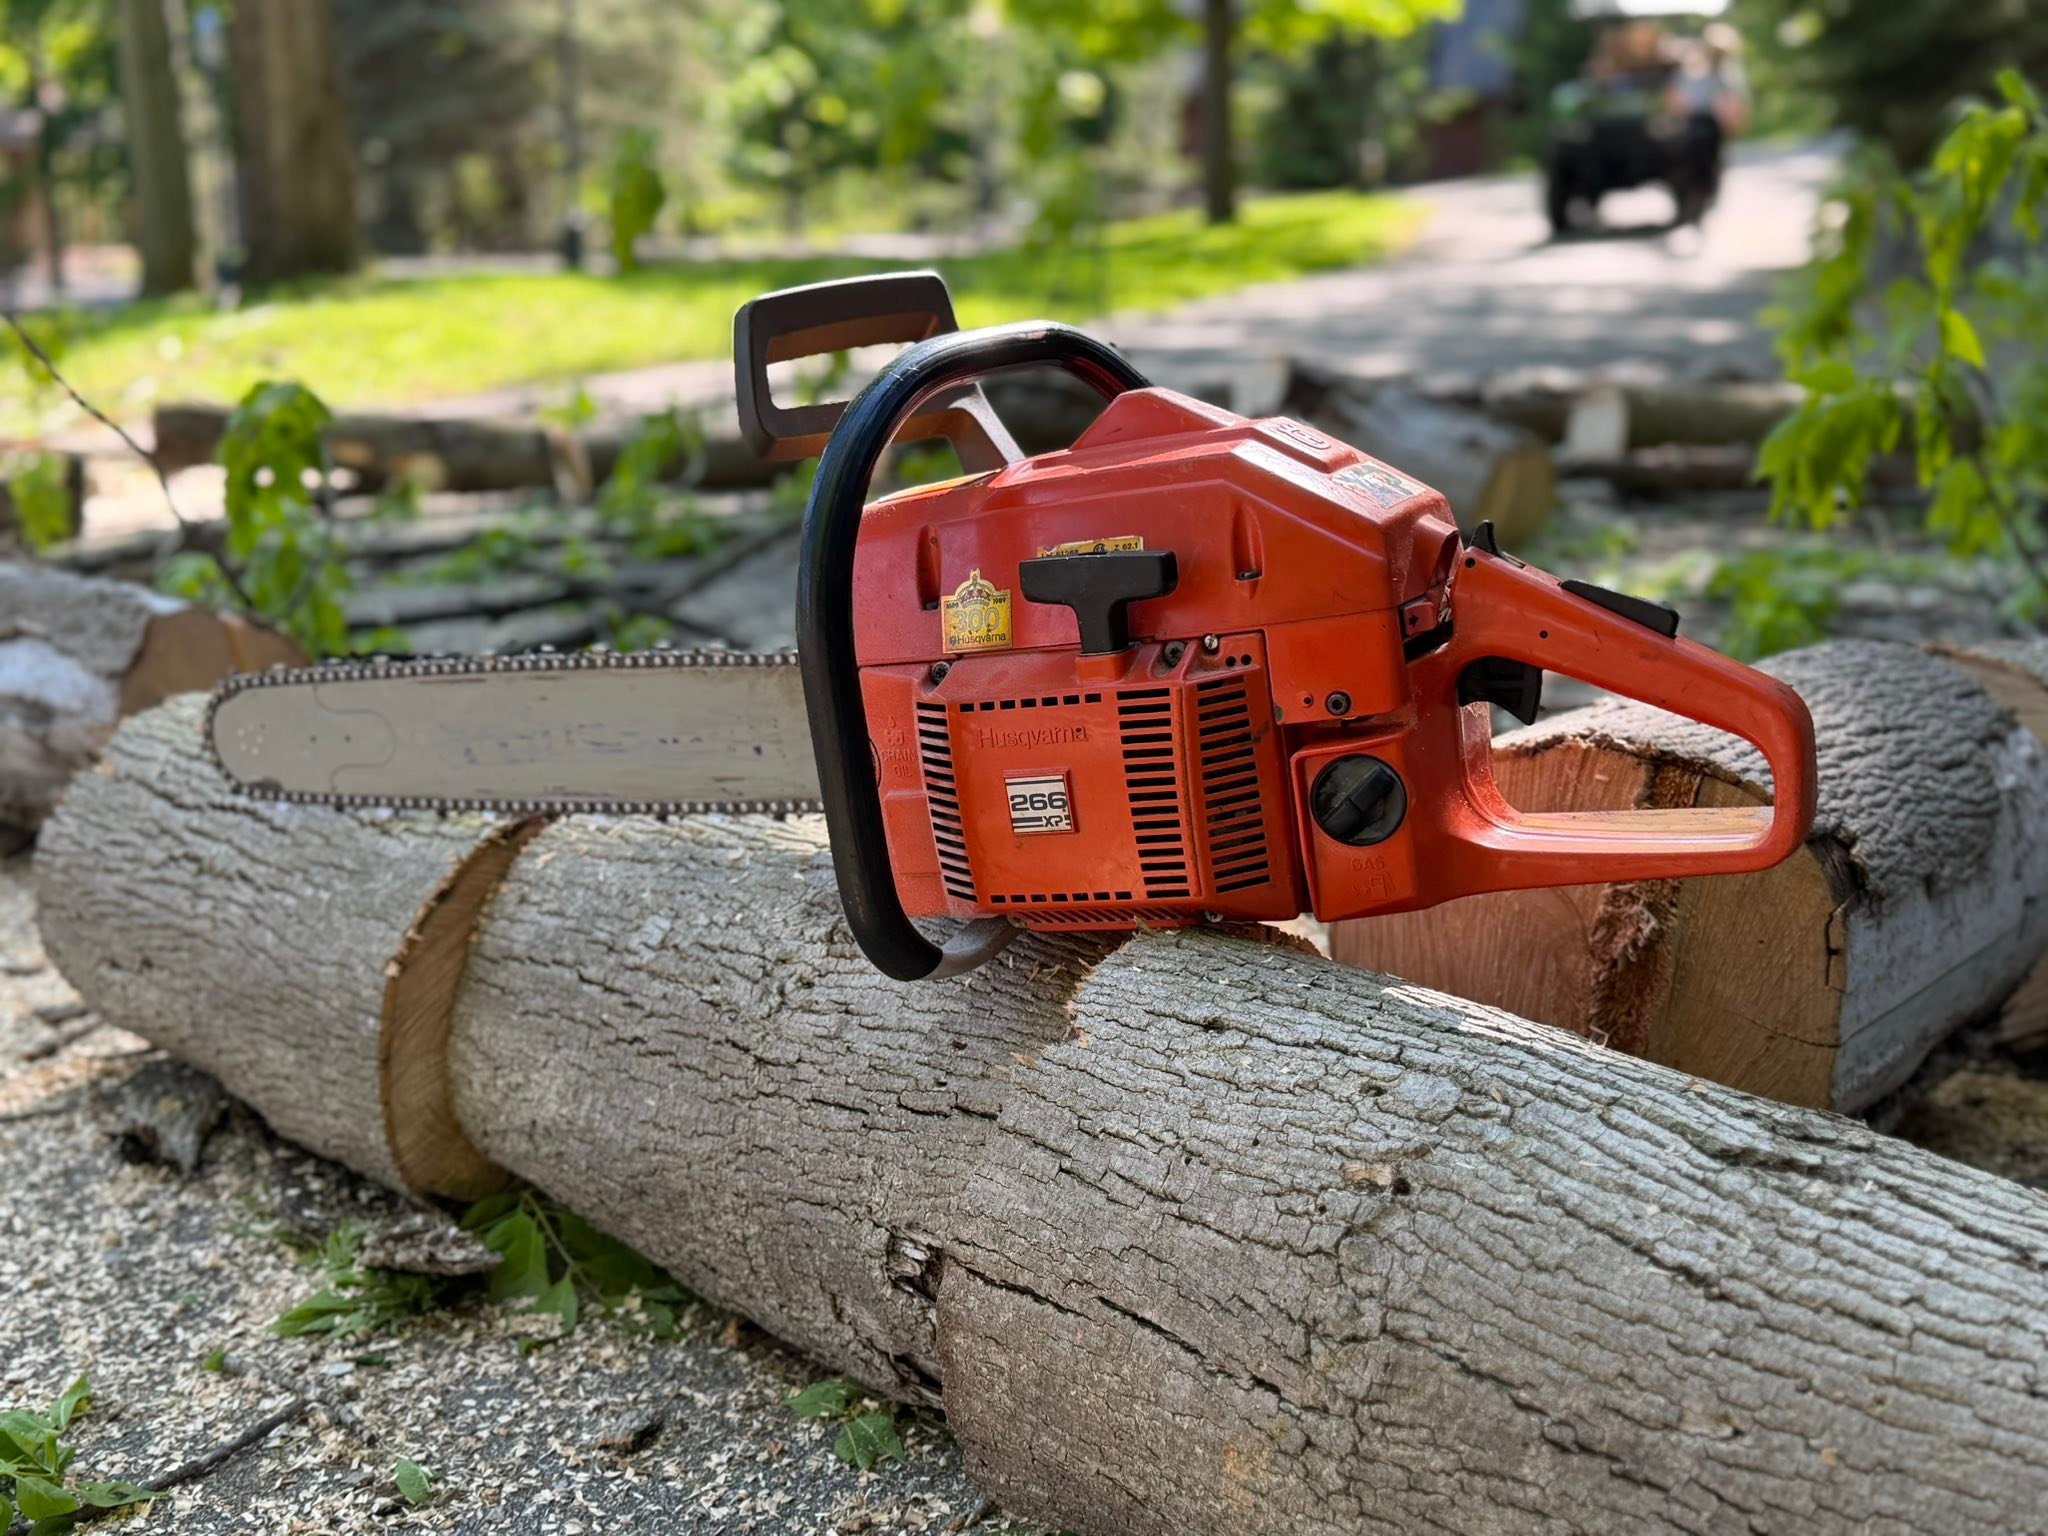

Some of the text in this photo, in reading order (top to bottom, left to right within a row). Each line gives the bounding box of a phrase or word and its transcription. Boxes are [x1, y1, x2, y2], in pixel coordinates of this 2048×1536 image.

[1122, 541, 1138, 551] 62.1
[954, 607, 1000, 633] 300
[957, 633, 1007, 645] Husqvarna
[979, 725, 1087, 749] Husqvarna
[882, 749, 918, 762] CHAIN
[894, 765, 912, 778] OIL
[1010, 791, 1067, 812] 266
[1043, 816, 1064, 828] XP
[1352, 855, 1385, 872] GAS
